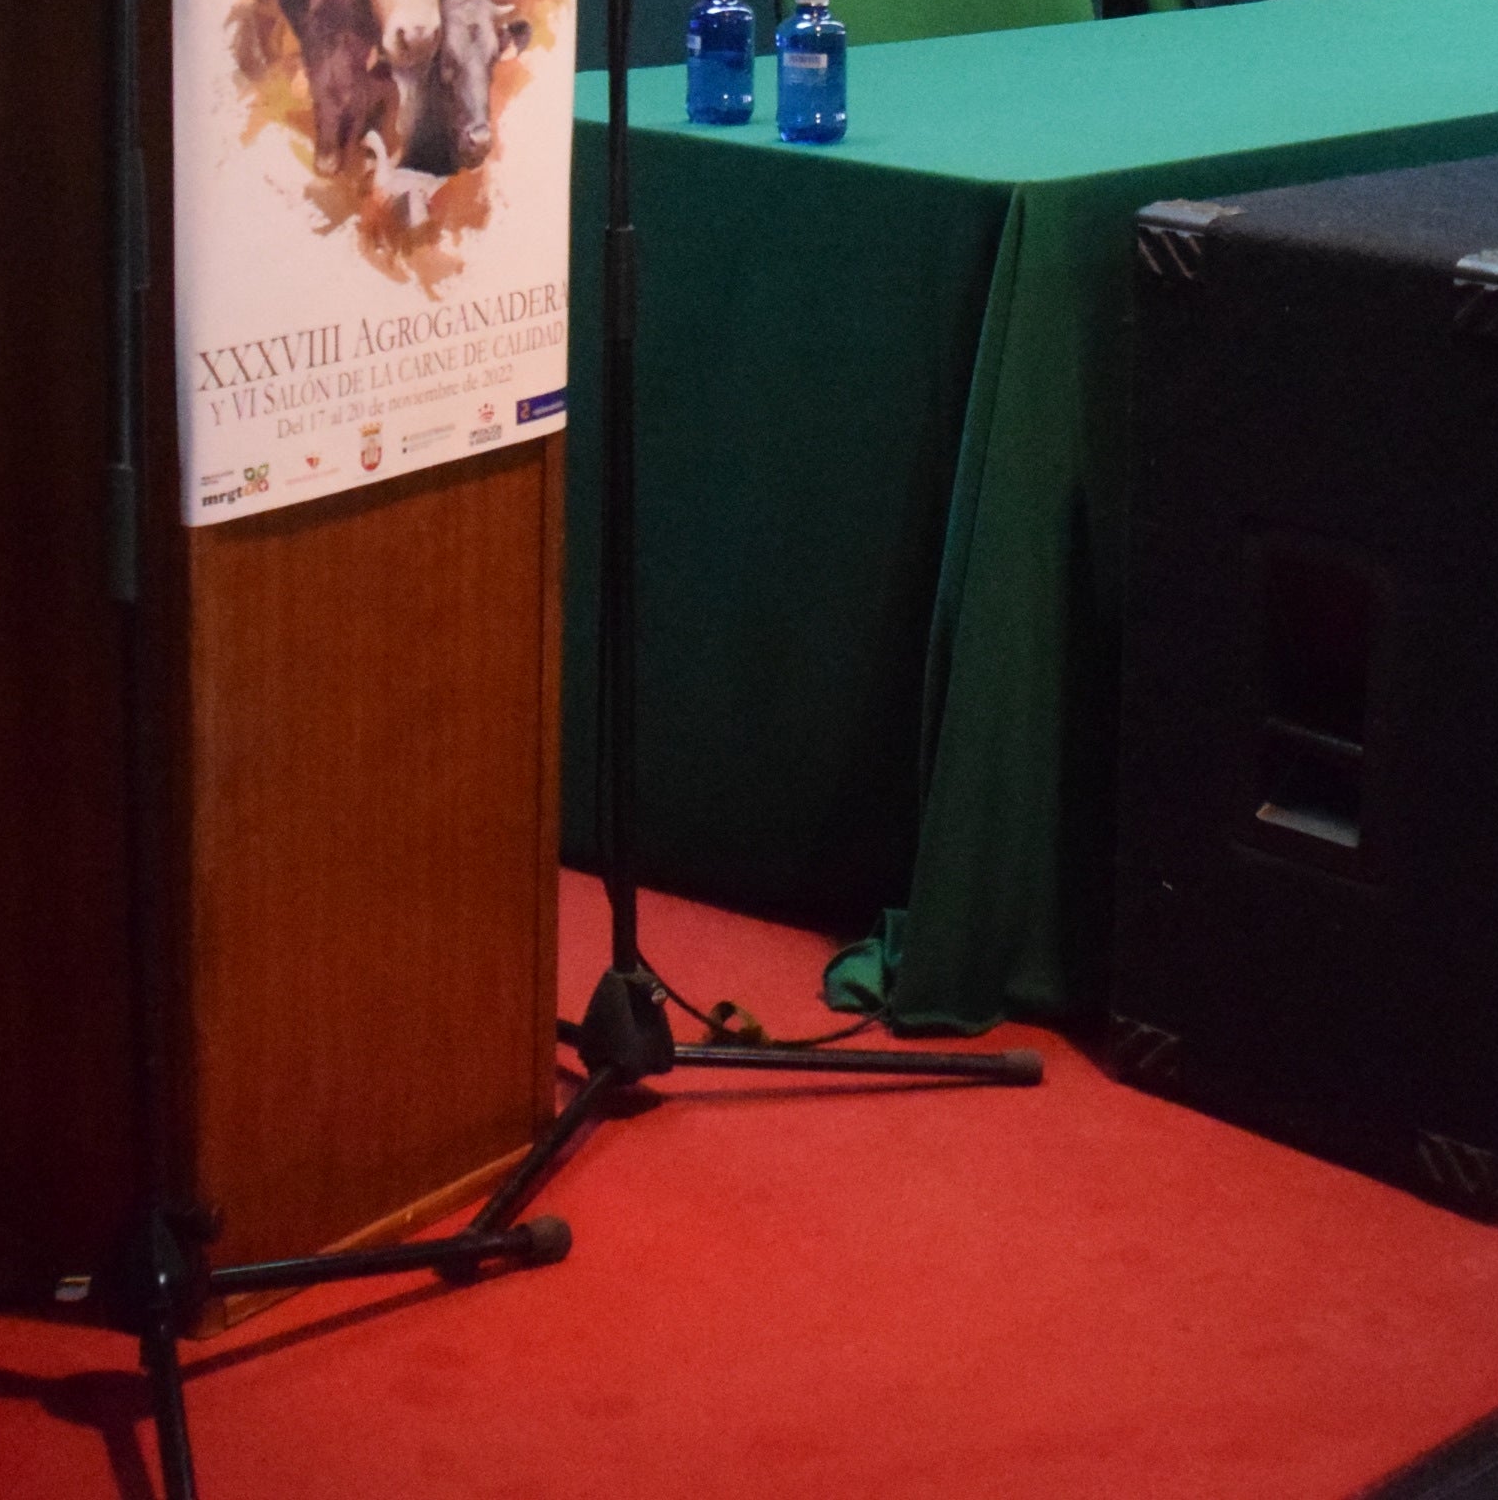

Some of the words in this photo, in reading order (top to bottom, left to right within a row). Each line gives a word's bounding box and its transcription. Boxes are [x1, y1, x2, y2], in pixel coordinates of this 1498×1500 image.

[196, 323, 343, 392] XXXVIII
[209, 399, 226, 427] Y
[231, 387, 258, 421] VI
[263, 372, 331, 415] SALÓN
[338, 368, 365, 399] DE
[370, 361, 394, 391] LA
[397, 347, 459, 383] CARNE
[463, 339, 489, 368] DE
[492, 320, 565, 360] CALIDAD
[276, 413, 304, 440] Del
[309, 409, 327, 431] 17
[368, 396, 386, 417] de
[388, 380, 460, 411] noviembre
[461, 372, 479, 394] de
